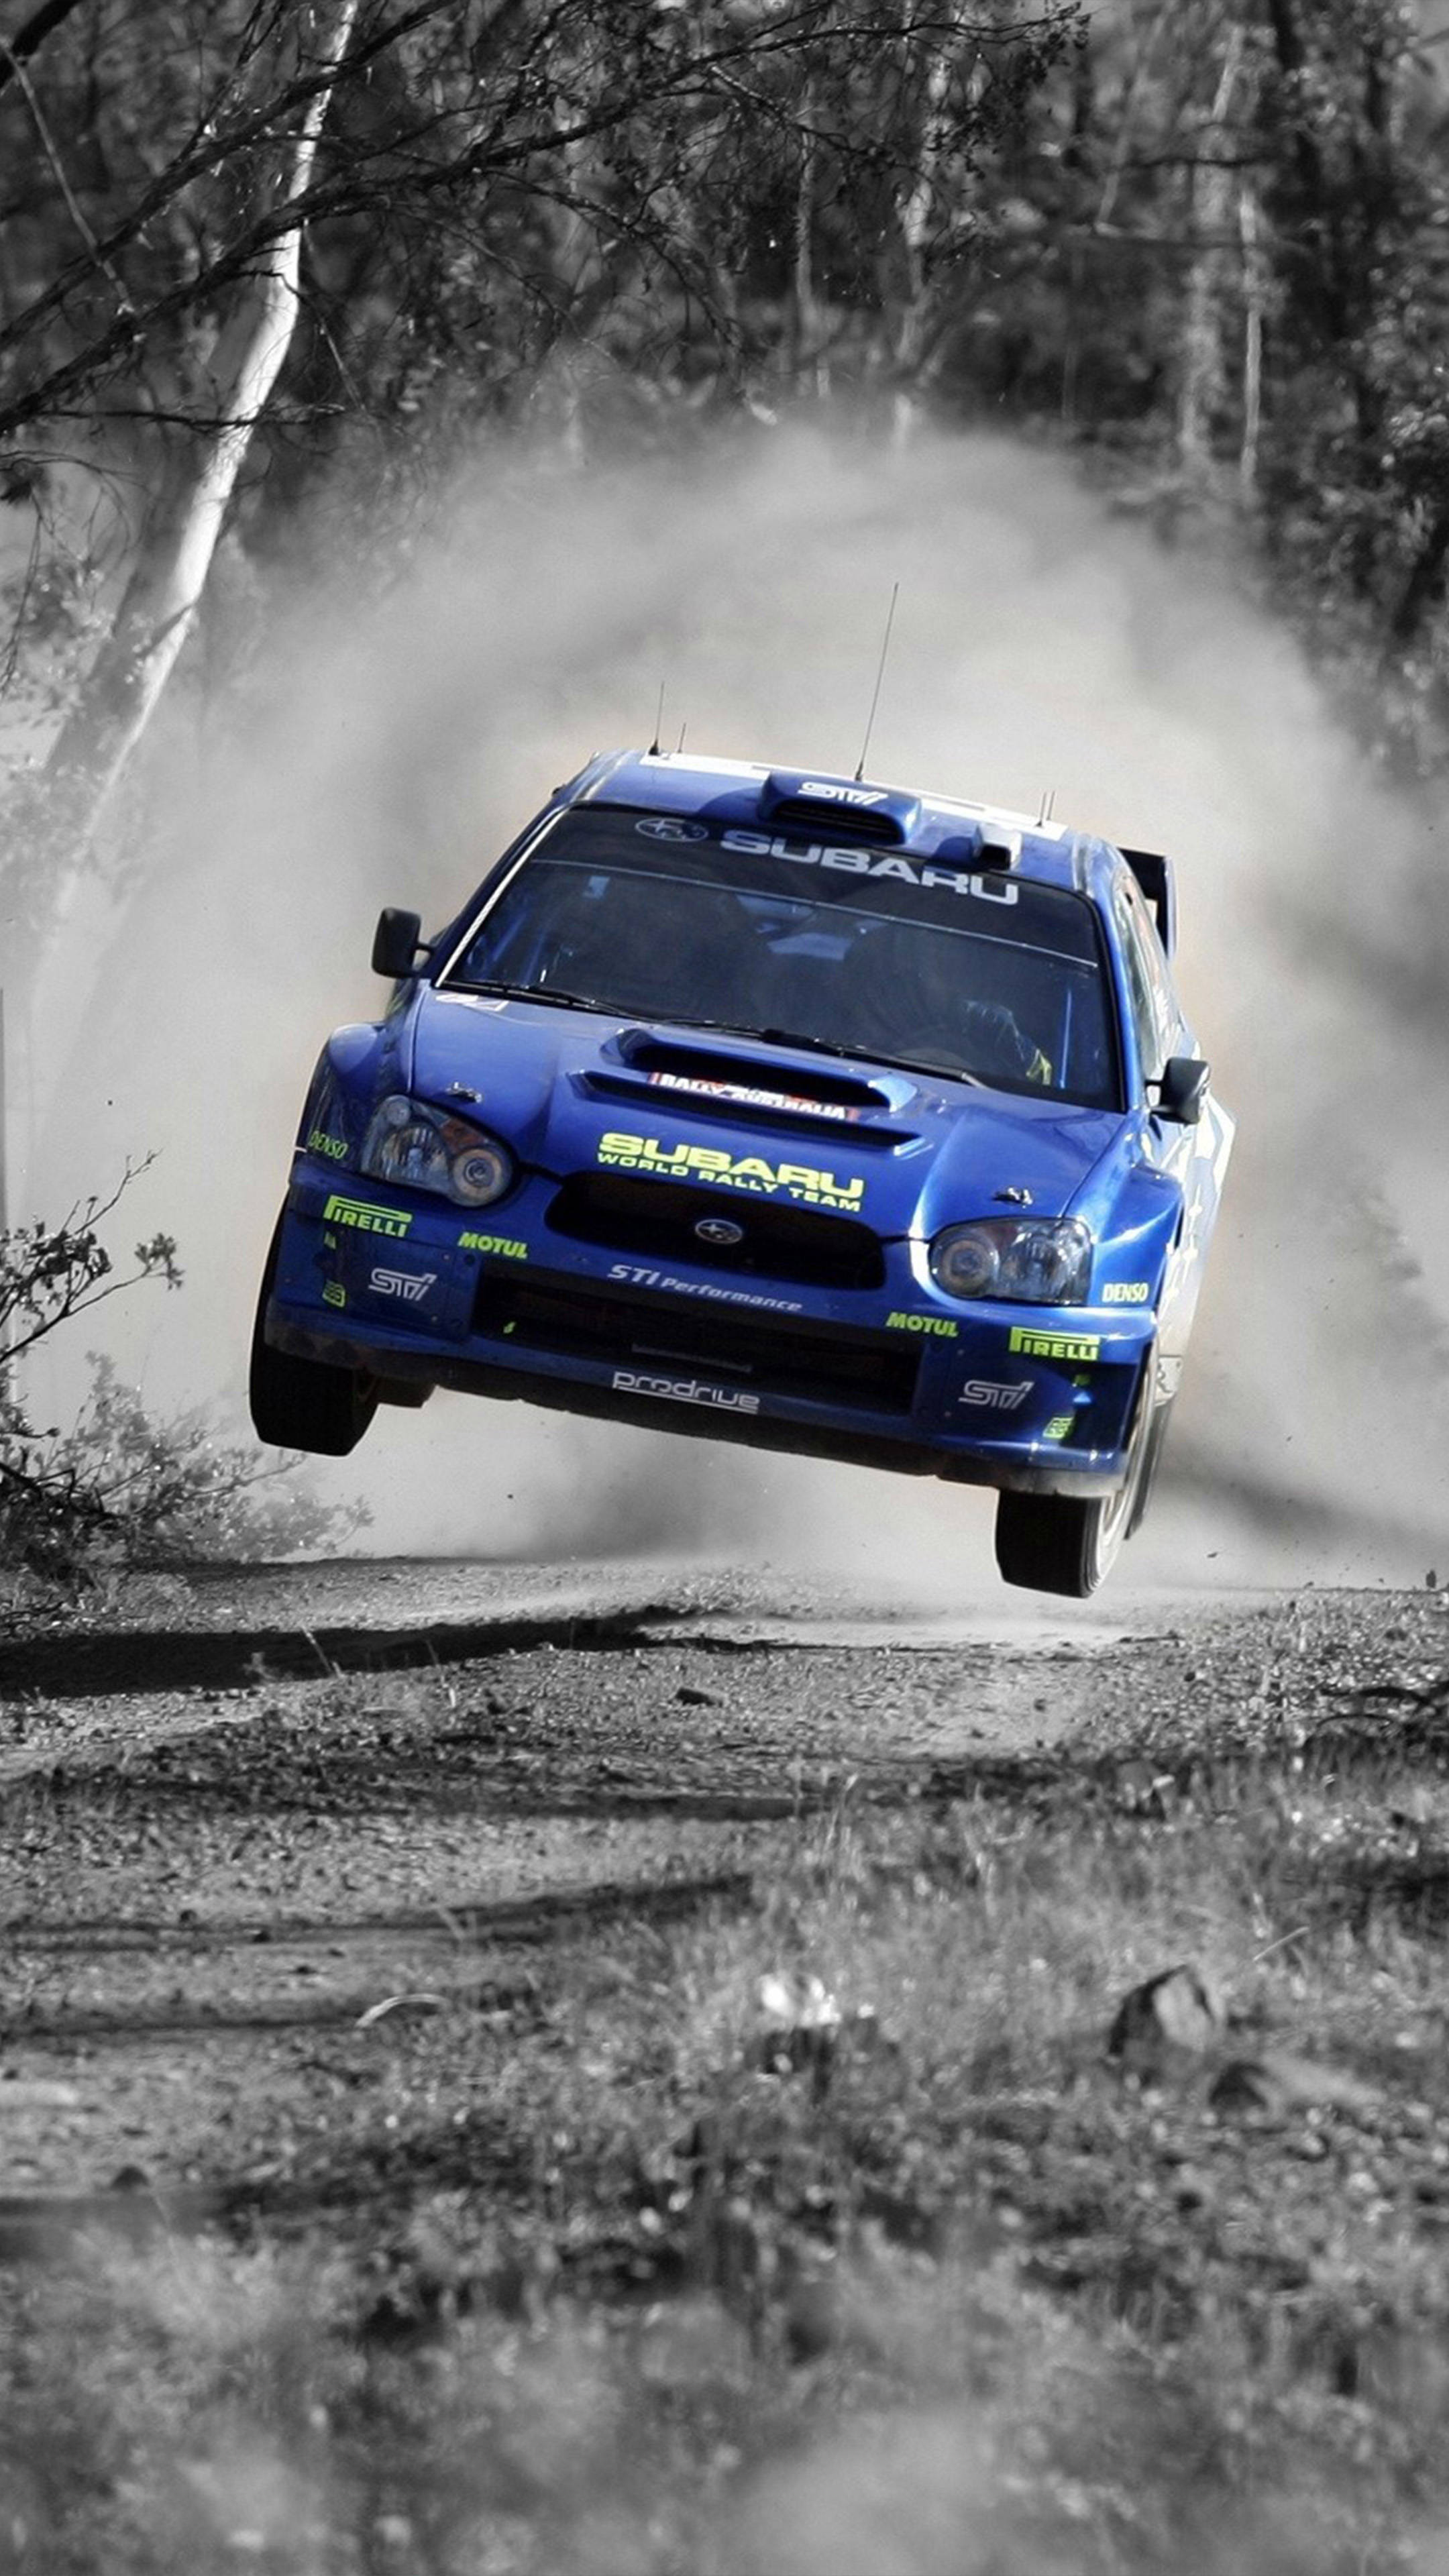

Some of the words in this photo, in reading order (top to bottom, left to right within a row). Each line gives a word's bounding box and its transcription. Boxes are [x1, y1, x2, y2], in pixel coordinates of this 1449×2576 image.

[720, 830, 1019, 906] SUBARU
[659, 1073, 725, 1095] RALLY
[309, 1130, 348, 1159] DENSO
[599, 1132, 865, 1198] SUBARU
[597, 1153, 688, 1177] WORLD
[698, 1169, 778, 1193] RALLY
[792, 1186, 861, 1212] TEAM
[323, 1195, 413, 1238] PIRELLI
[458, 1232, 528, 1259] MOTUL
[661, 1277, 802, 1311] Performance
[1102, 1282, 1149, 1303] DENSO
[885, 1311, 959, 1338] MOTUL
[1008, 1327, 1100, 1360] PIRELLI
[612, 1372, 760, 1413] prodrive
